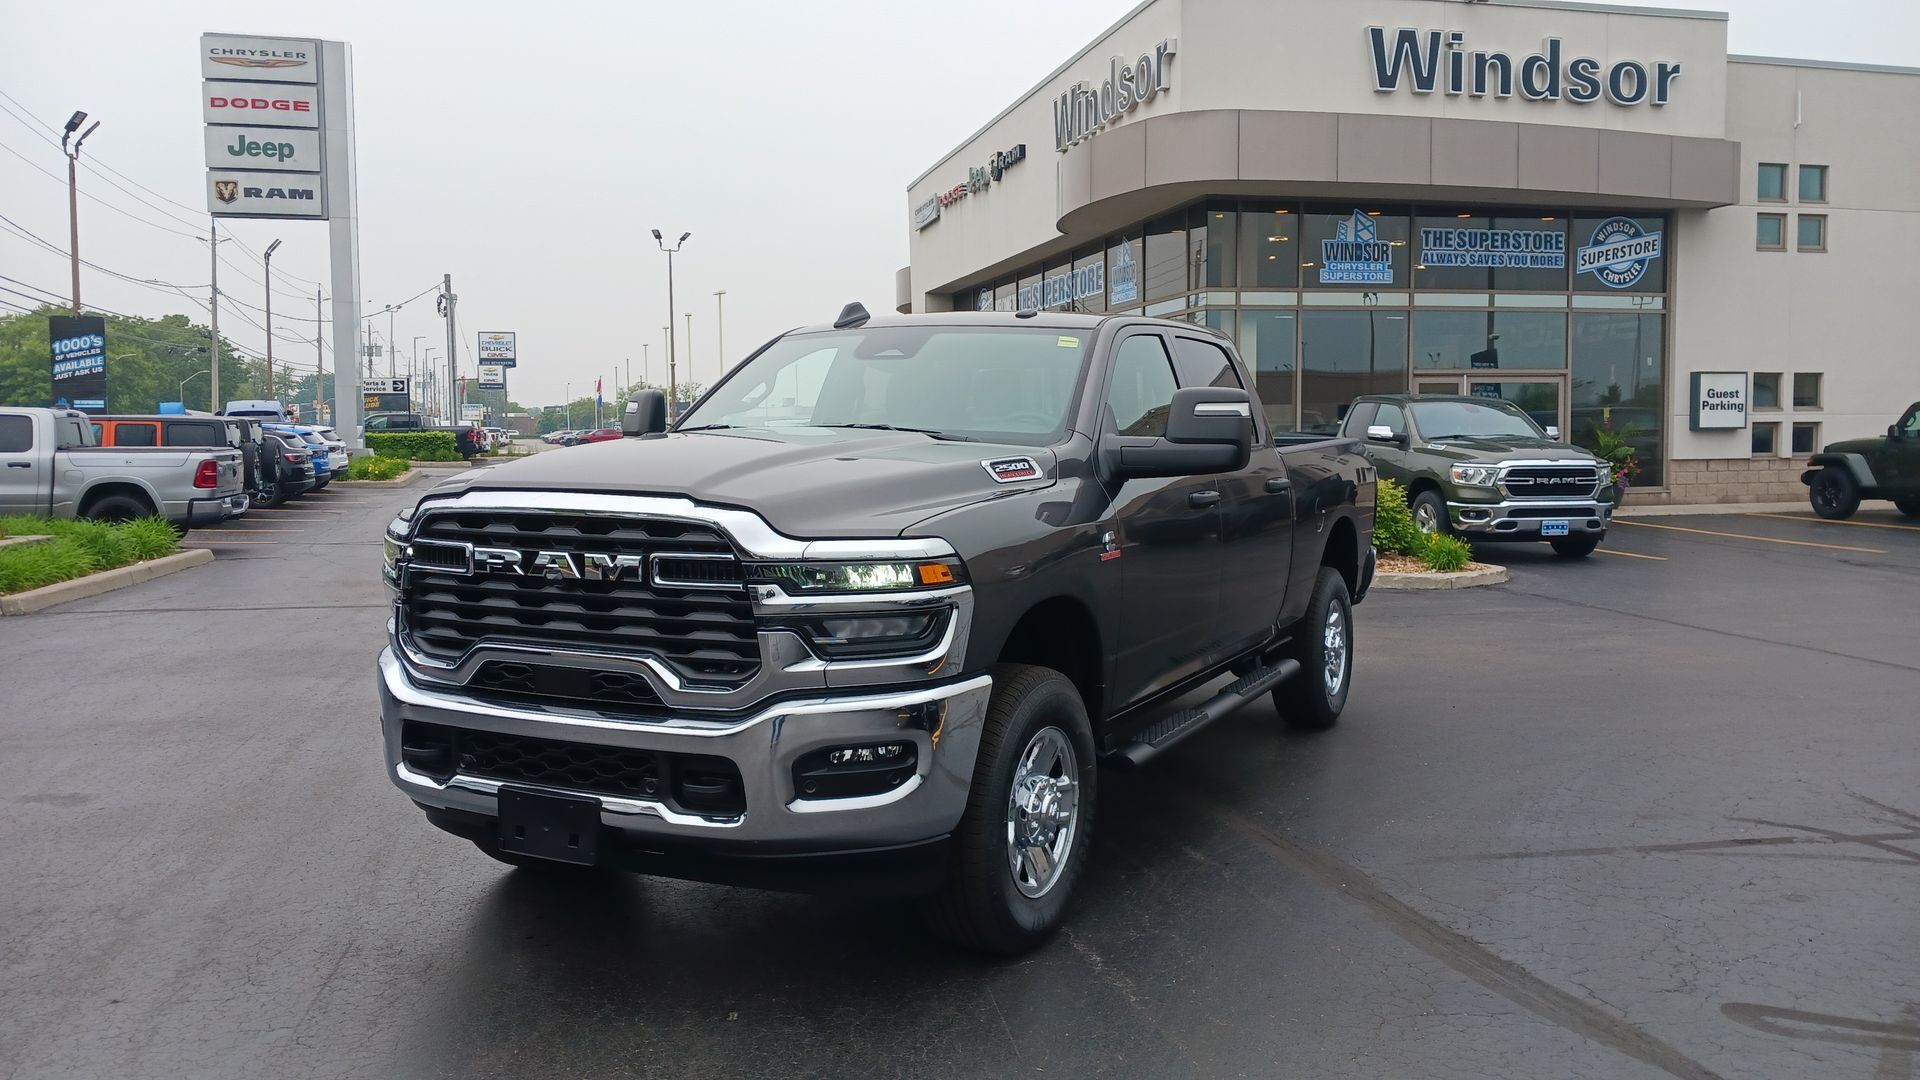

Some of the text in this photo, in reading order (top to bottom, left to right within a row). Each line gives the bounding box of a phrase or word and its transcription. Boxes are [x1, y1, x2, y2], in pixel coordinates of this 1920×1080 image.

[210, 48, 307, 59] CHRYSLER
[1367, 26, 1681, 106] Windsor
[1053, 39, 1177, 152] Windsor
[210, 97, 310, 112] DODGE
[227, 135, 295, 162] Jeep
[243, 187, 314, 200] RAM
[1596, 222, 1636, 242] WINDSOR
[1422, 230, 1564, 251] THE SUPERSTORE
[1324, 242, 1390, 261] WINDSOR
[1422, 252, 1564, 266] ALWAYS SAVES YOU MORE!
[1580, 239, 1658, 267] SUPERSTORE
[1323, 272, 1391, 280] SUPERSTORE
[1603, 262, 1642, 283] CHRYSLER
[1032, 261, 1104, 309] SUPERSTORE
[52, 336, 103, 353] 1000's
[55, 348, 101, 361] OF VEHICLES
[53, 357, 103, 373] AVAILABLE
[54, 372, 73, 380] JUST
[74, 369, 90, 377] ASK
[1707, 388, 1740, 399] Guest
[1702, 400, 1744, 413] Parking
[994, 461, 1030, 472] 2500
[473, 547, 643, 583] RAM
